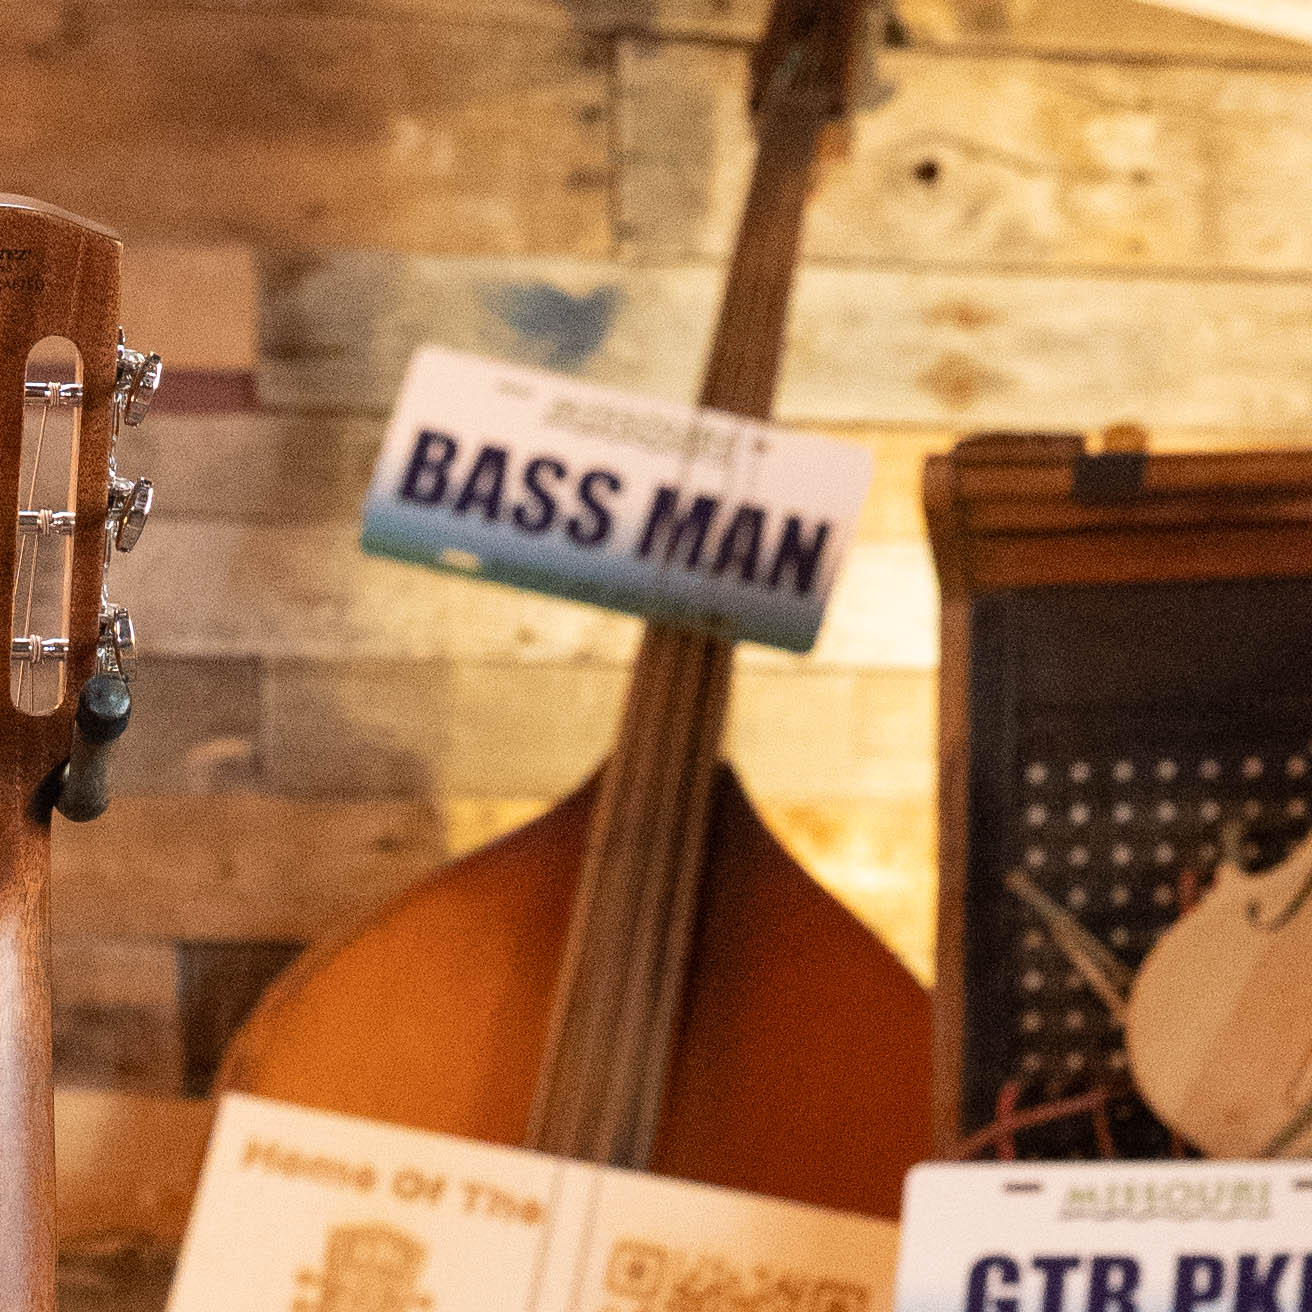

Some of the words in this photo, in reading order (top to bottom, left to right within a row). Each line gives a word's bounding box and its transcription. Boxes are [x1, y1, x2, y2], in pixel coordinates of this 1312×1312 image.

[398, 427, 622, 548] BASS
[639, 485, 830, 596] MAN
[239, 1137, 377, 1195] Home
[459, 1176, 549, 1226] The
